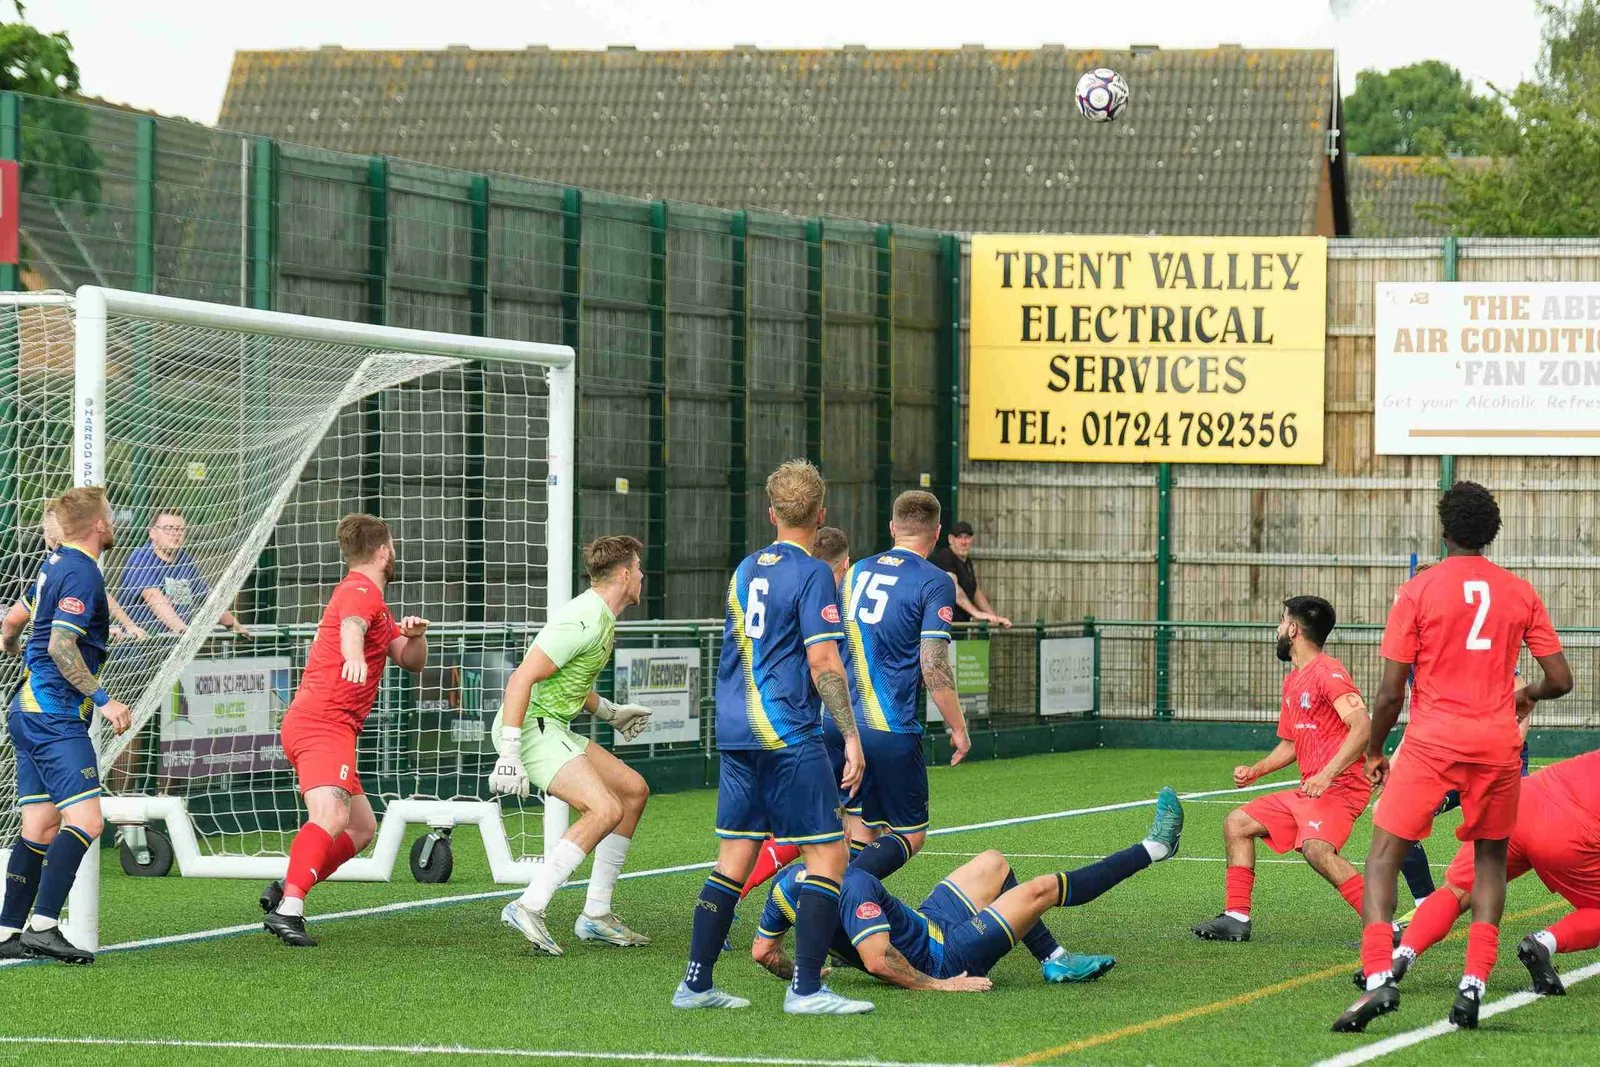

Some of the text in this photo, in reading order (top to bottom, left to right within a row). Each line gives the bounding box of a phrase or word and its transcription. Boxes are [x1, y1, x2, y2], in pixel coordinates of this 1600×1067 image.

[995, 249, 1303, 291] TRENT VALLEY
[1020, 304, 1274, 345] ELECTRICAL
[1463, 294, 1530, 320] THE
[1393, 328, 1600, 354] AIR CONDITI
[1047, 355, 1247, 395] SERVICES
[1382, 394, 1412, 409] Get
[1421, 397, 1459, 412] your
[1466, 394, 1536, 409] Alcoholic
[84, 409, 94, 459] HARROD
[995, 409, 1298, 448] TEL: 01724 782356
[744, 577, 770, 640] 6
[847, 571, 899, 625] 15
[1463, 580, 1492, 650] 2
[339, 764, 349, 780] 6
